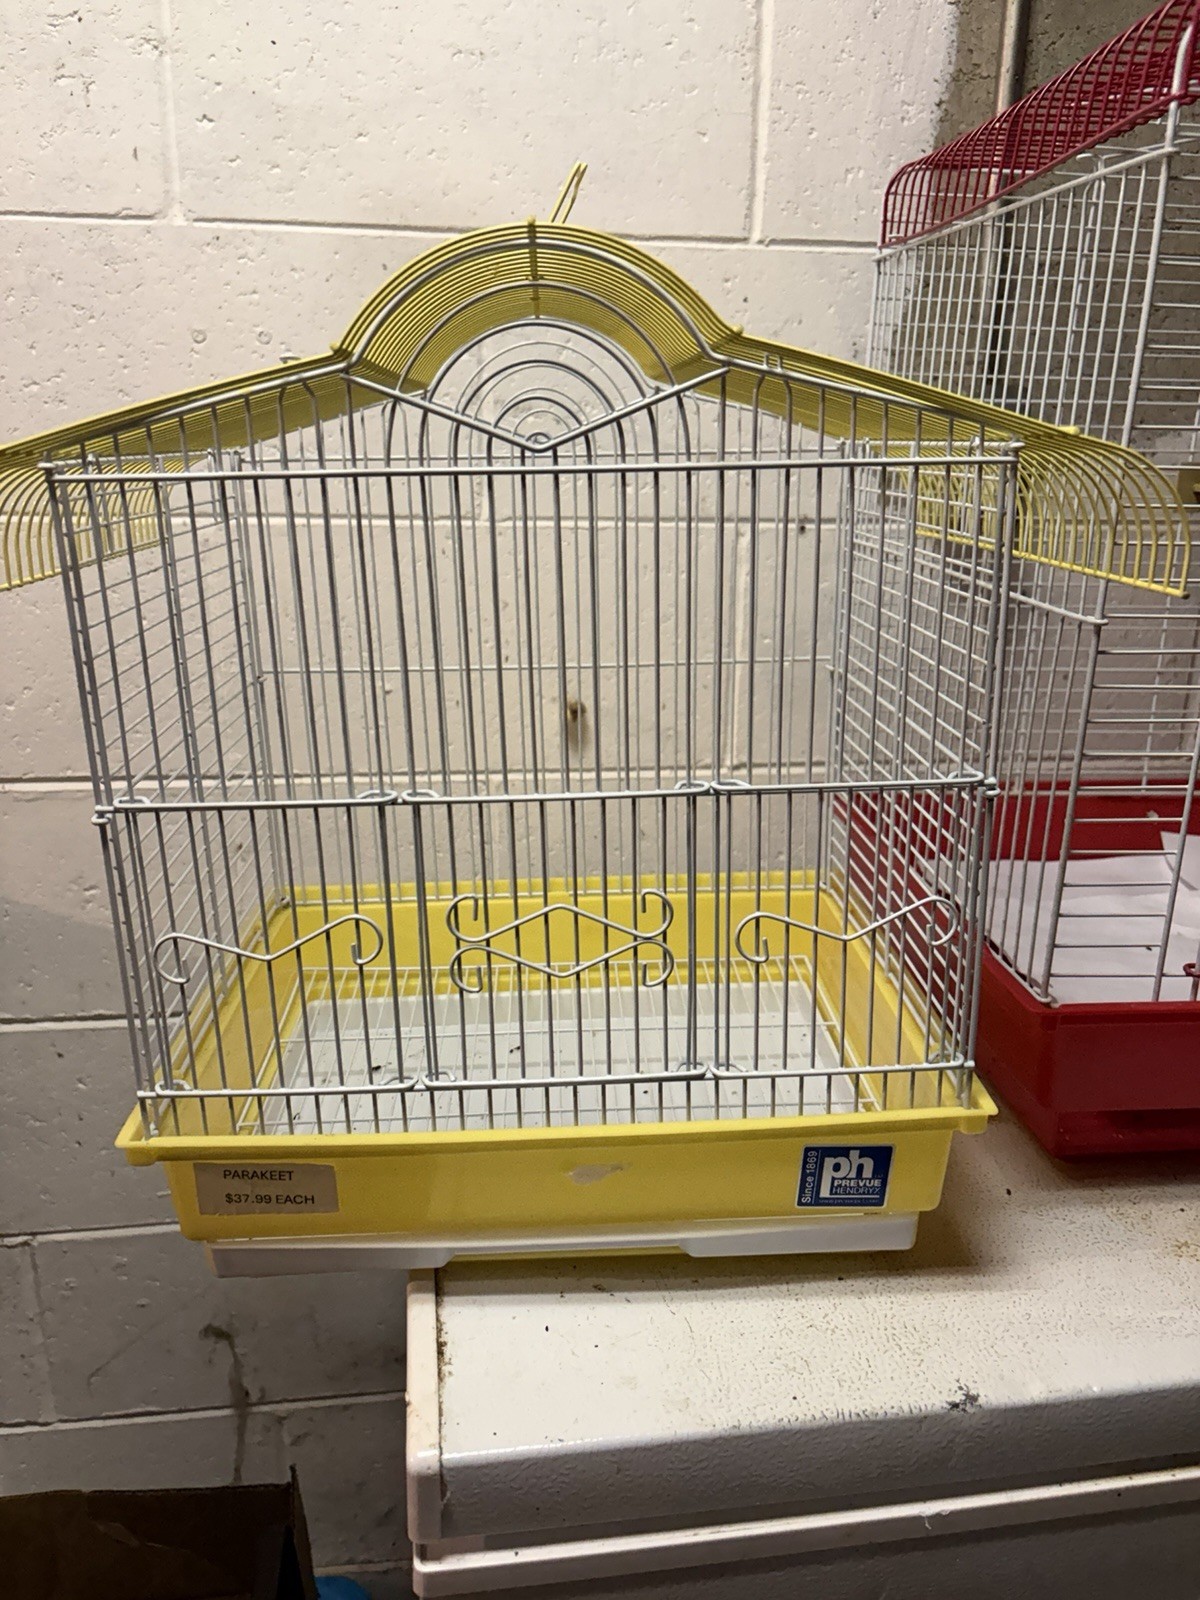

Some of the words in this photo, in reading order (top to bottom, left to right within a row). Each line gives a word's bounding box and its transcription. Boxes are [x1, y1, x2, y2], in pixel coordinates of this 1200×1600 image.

[805, 1150, 818, 1174] 1869
[223, 1169, 294, 1181] PARAKEET
[819, 1149, 874, 1198] ph
[801, 1176, 815, 1203] Since
[833, 1179, 882, 1187] PREVUE
[225, 1193, 272, 1205] $37.99
[275, 1194, 315, 1205] EACH
